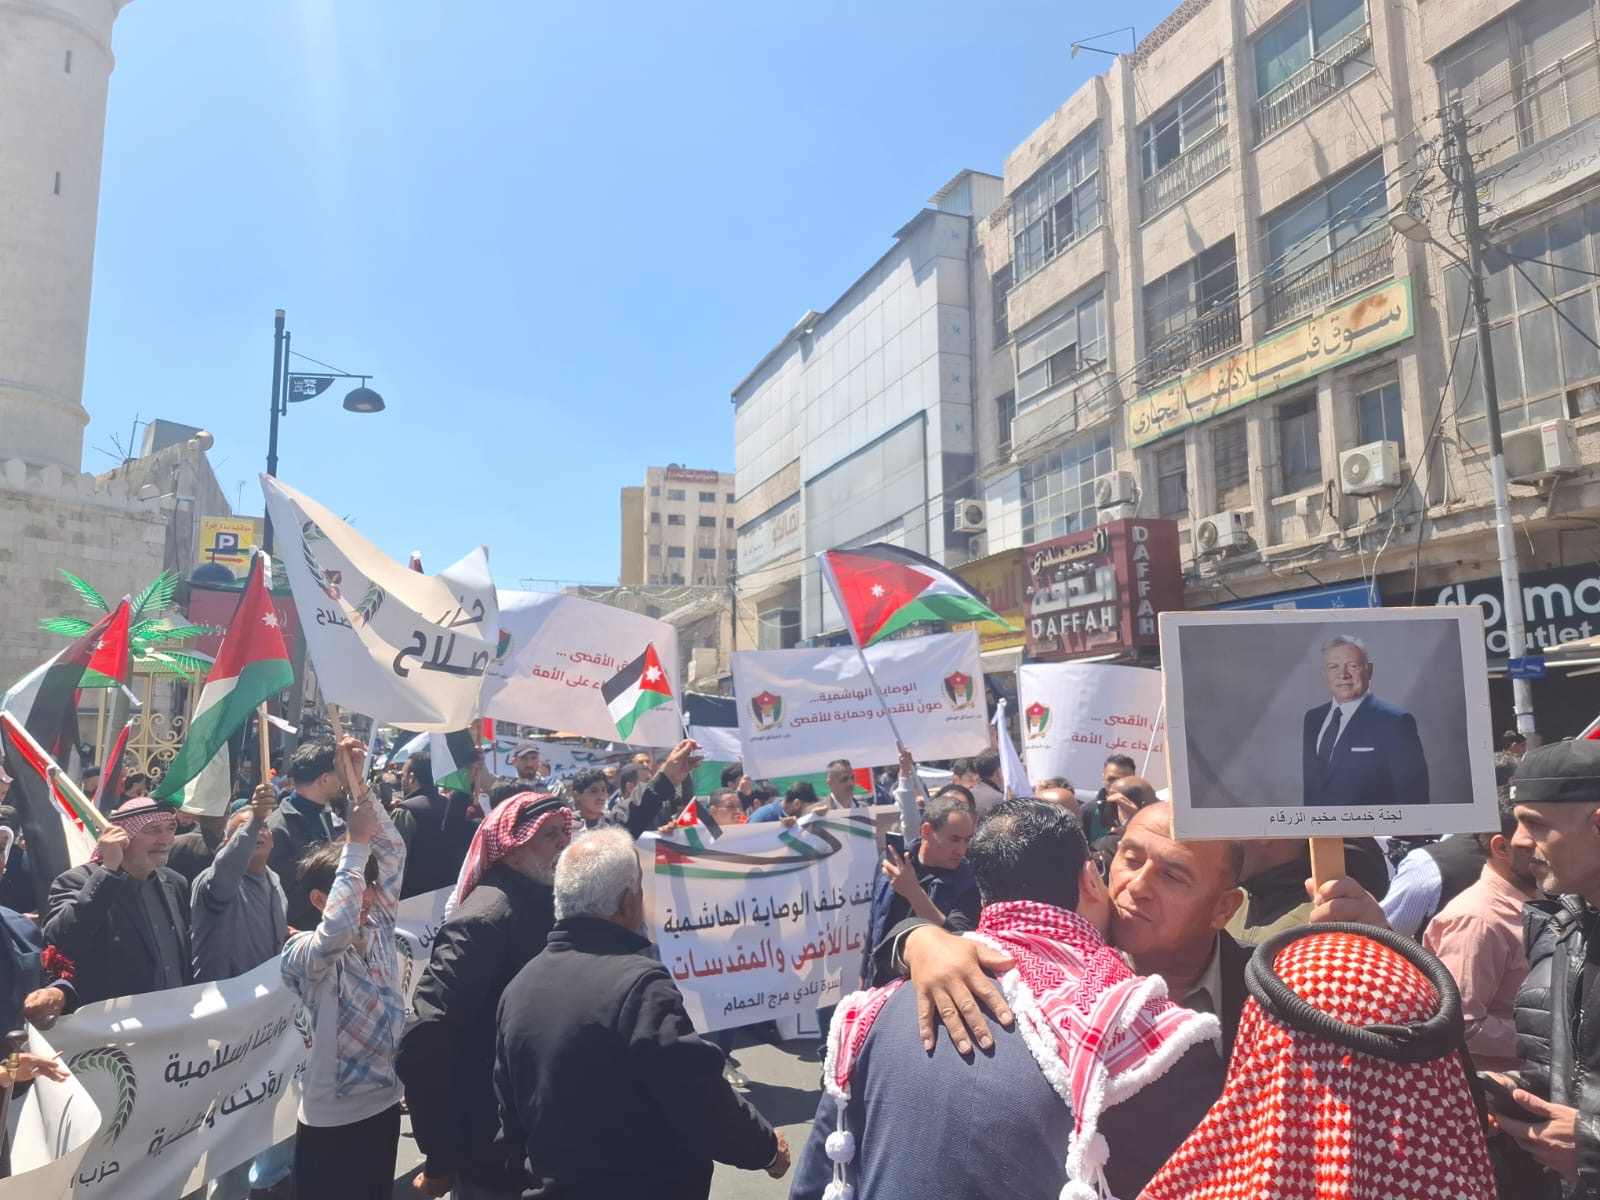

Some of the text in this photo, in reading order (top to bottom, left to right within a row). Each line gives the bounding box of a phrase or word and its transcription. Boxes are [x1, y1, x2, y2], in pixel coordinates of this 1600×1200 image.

[1323, 303, 1402, 355] سوق
[1184, 324, 1321, 413] فيلادلفيا
[218, 534, 235, 549] P
[1131, 525, 1155, 635] DAFFAH
[1031, 604, 1116, 639] DAFFAH
[569, 651, 615, 668] الأقصى
[532, 665, 565, 682] الأمة
[566, 675, 589, 688] على
[878, 682, 917, 697] الوصاي
[790, 712, 832, 728] للأقصى
[834, 709, 873, 724] وحماية
[1104, 713, 1148, 728] الأقصى
[1071, 731, 1163, 754] اعداء على الأمة
[1269, 809, 1403, 826] لجنة خدمات مخيم الزرقاء
[751, 890, 810, 928] الوصاية
[813, 885, 847, 912] خلف
[663, 901, 747, 940] الهاشمية
[790, 923, 842, 972] للأقصى
[672, 937, 785, 982] والمقدسات
[723, 992, 765, 1016] الحمام
[767, 992, 790, 1009] مرج
[792, 981, 819, 1004] نادي
[79, 1160, 120, 1186] حزب
